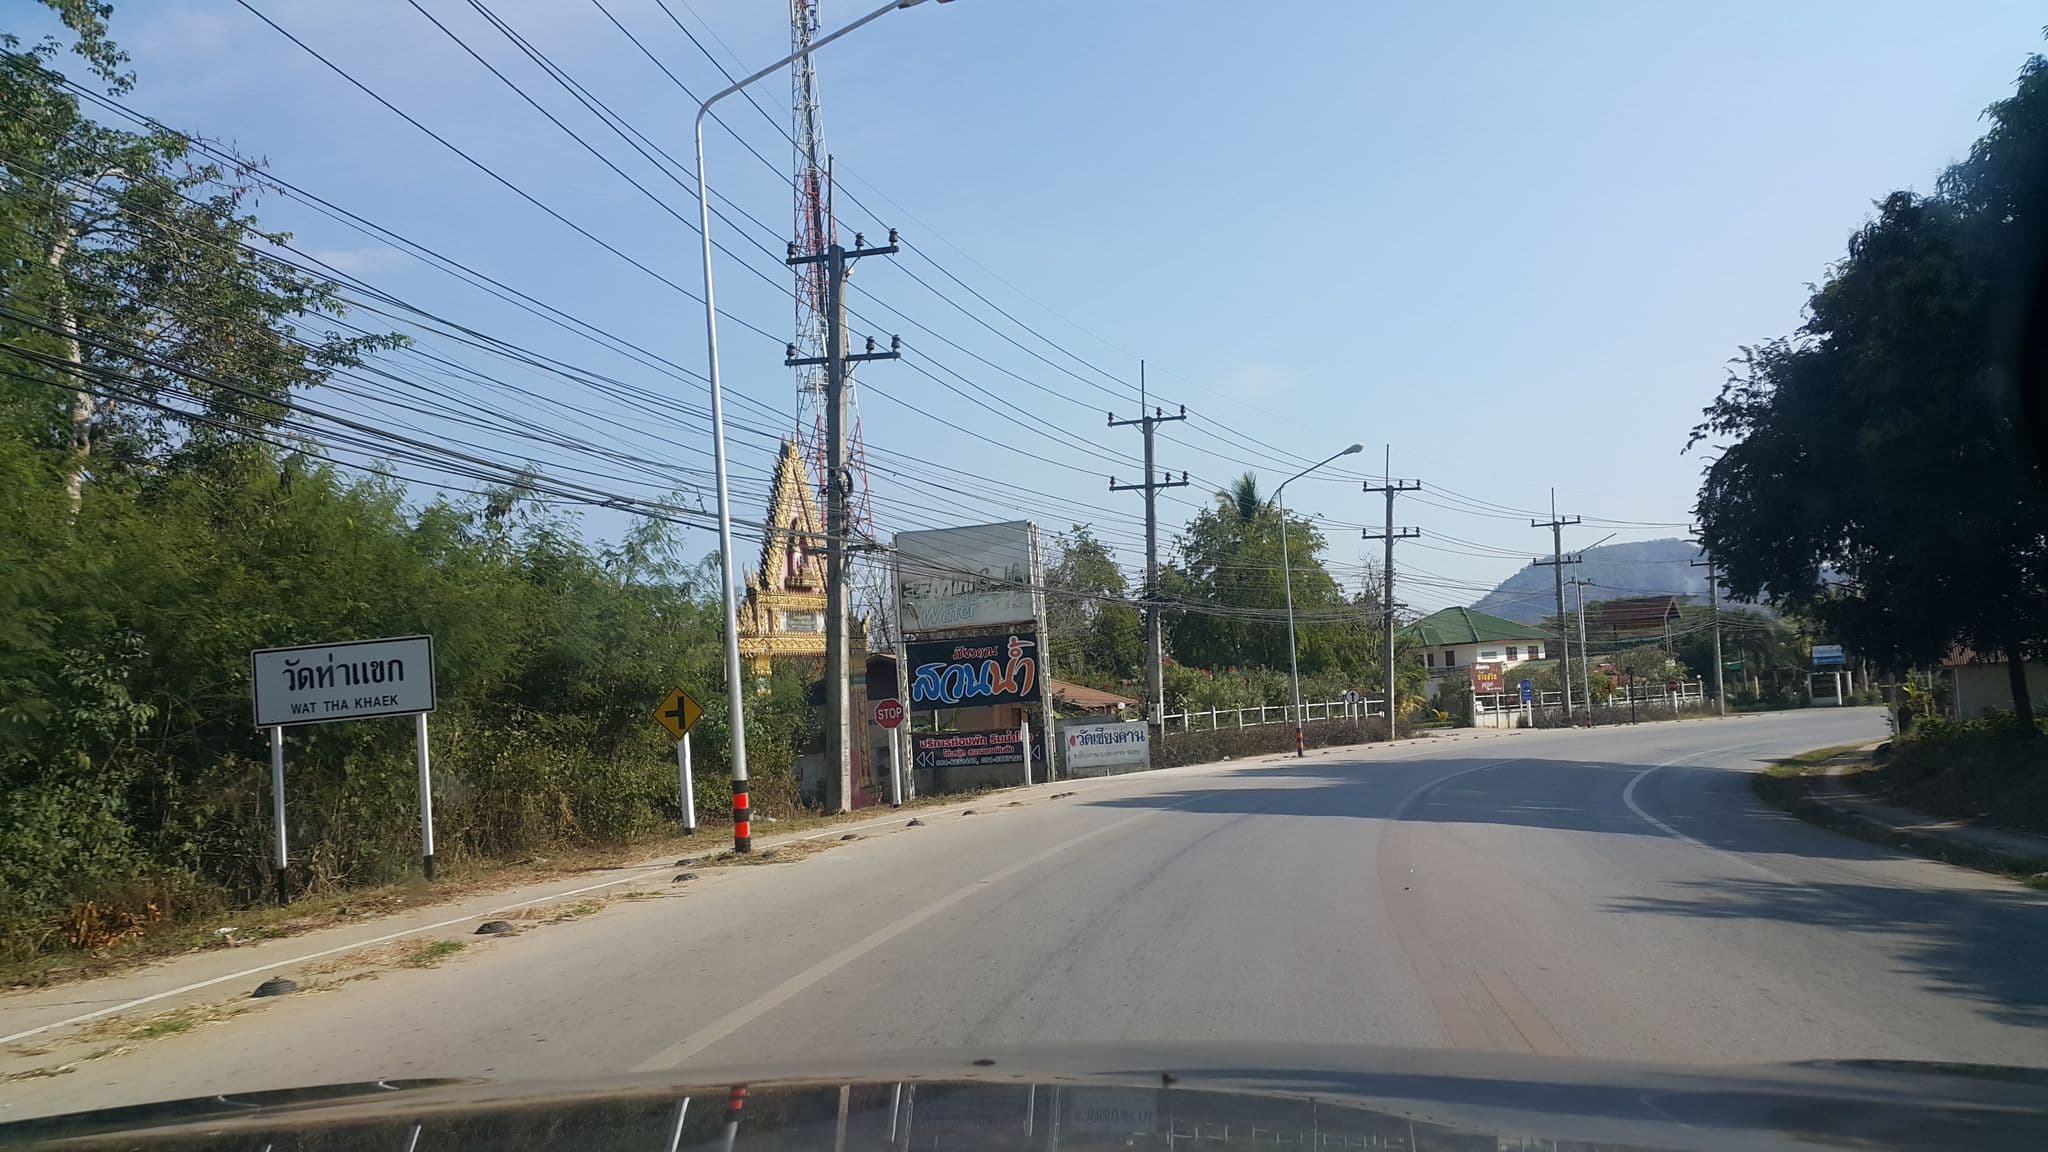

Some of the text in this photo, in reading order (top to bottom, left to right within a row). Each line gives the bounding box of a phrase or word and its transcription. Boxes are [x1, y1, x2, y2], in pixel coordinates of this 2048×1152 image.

[919, 601, 978, 626] Water
[282, 653, 404, 691] วัดท่าแขก
[912, 636, 1036, 704] สวนน้ำ
[290, 695, 399, 715] WAT THA KHAEK
[877, 707, 902, 720] STOP
[920, 735, 988, 749] บริการห้องพัก
[1076, 727, 1146, 746] วัดเชียงคาน
